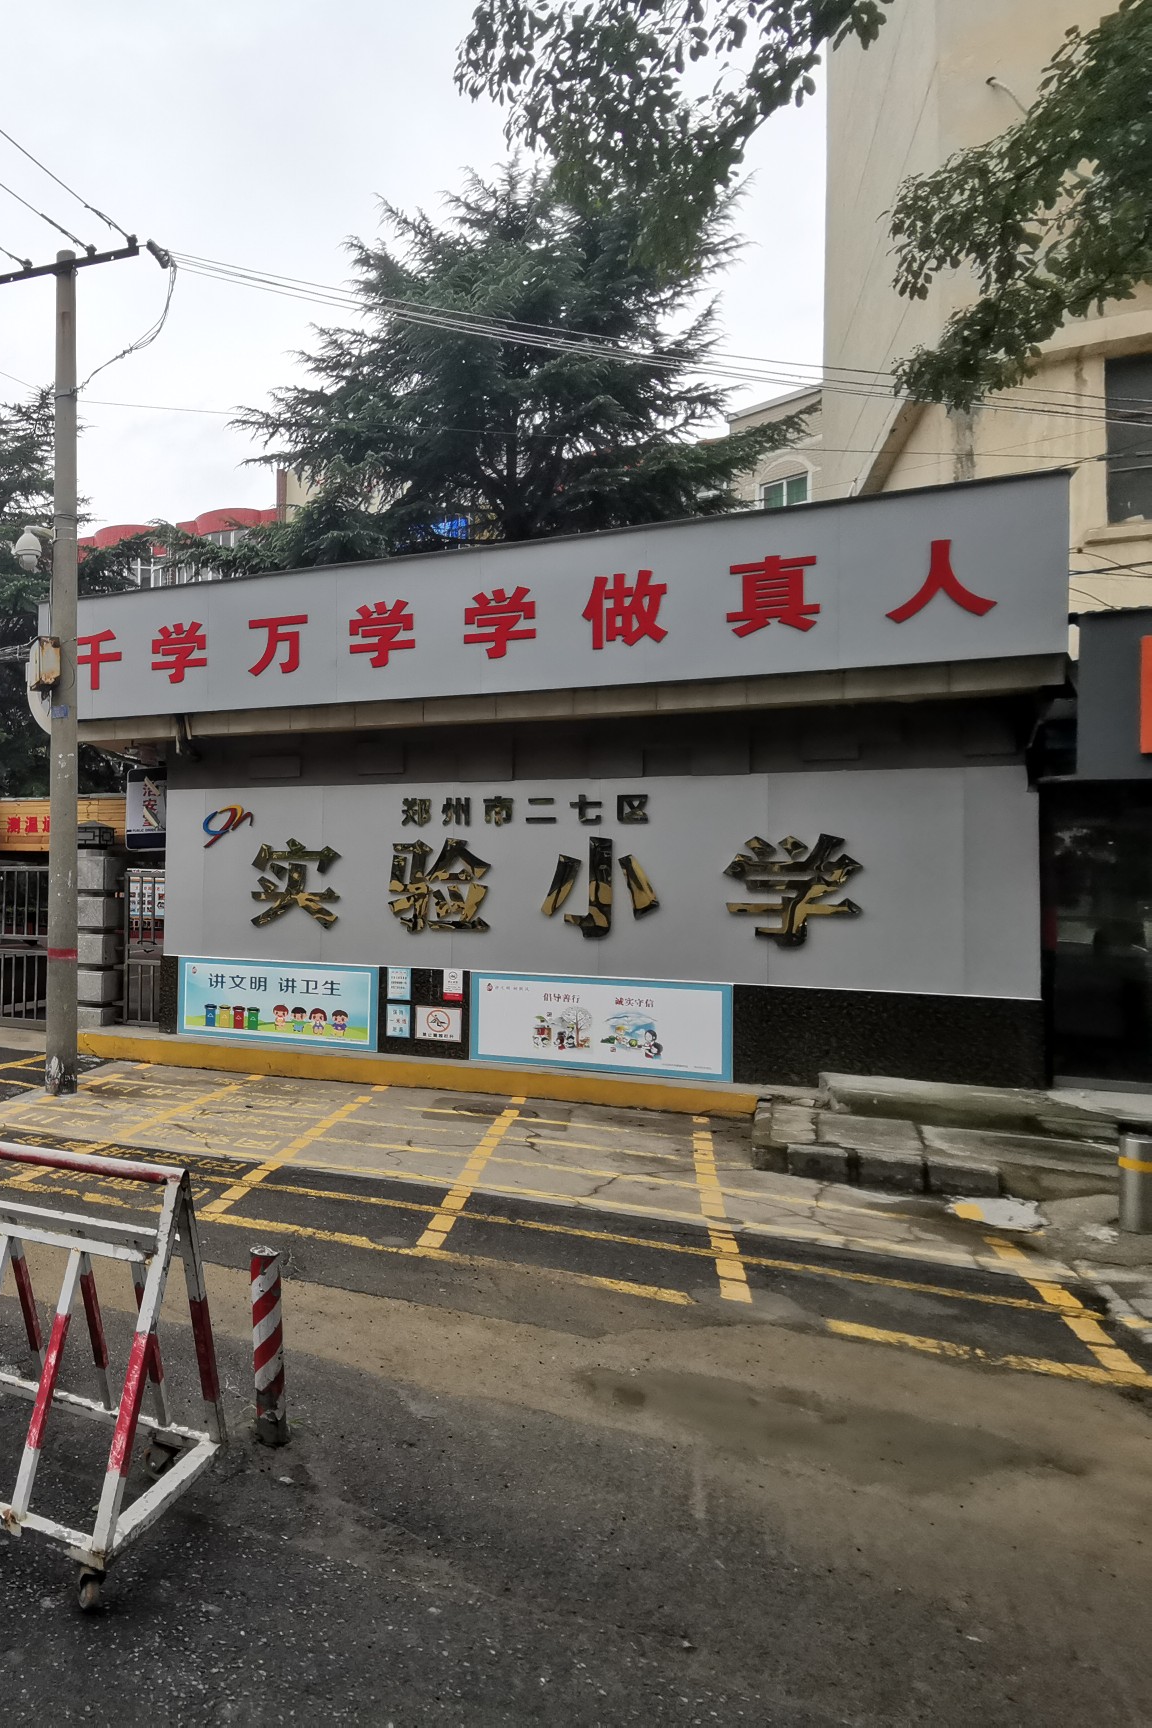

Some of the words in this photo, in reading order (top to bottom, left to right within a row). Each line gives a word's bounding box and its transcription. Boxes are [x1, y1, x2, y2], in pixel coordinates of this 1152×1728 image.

[77, 538, 995, 690] 千学万学学做真人
[402, 794, 650, 827] 郑州市二七区
[250, 834, 864, 947] 实验小学
[209, 973, 267, 992] 讲文明
[279, 977, 342, 997] 讲卫生
[543, 993, 580, 1003] 倡导善行
